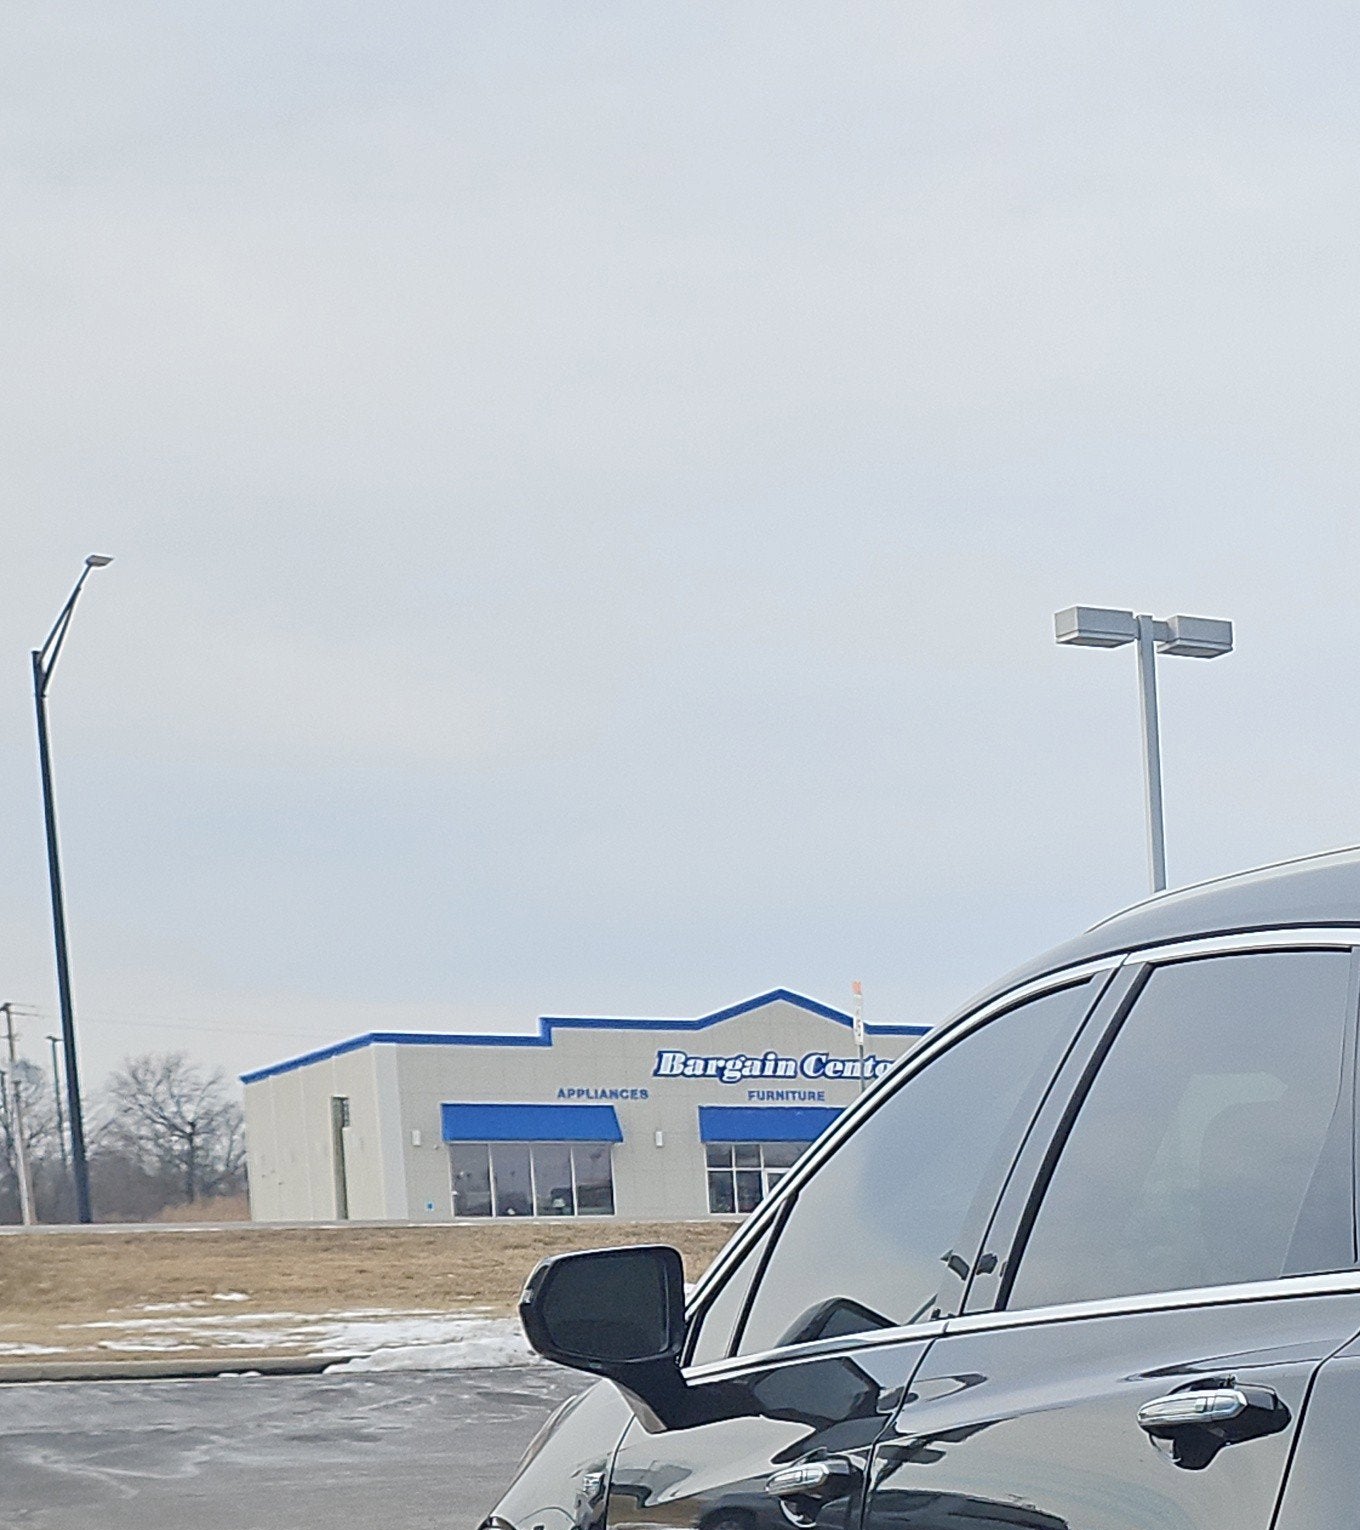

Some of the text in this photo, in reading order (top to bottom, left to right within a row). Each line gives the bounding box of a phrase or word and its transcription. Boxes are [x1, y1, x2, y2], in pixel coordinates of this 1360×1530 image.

[654, 1050, 797, 1083] Bargain
[557, 1088, 649, 1100] APPLIANCES
[747, 1090, 825, 1101] FURNITURE
